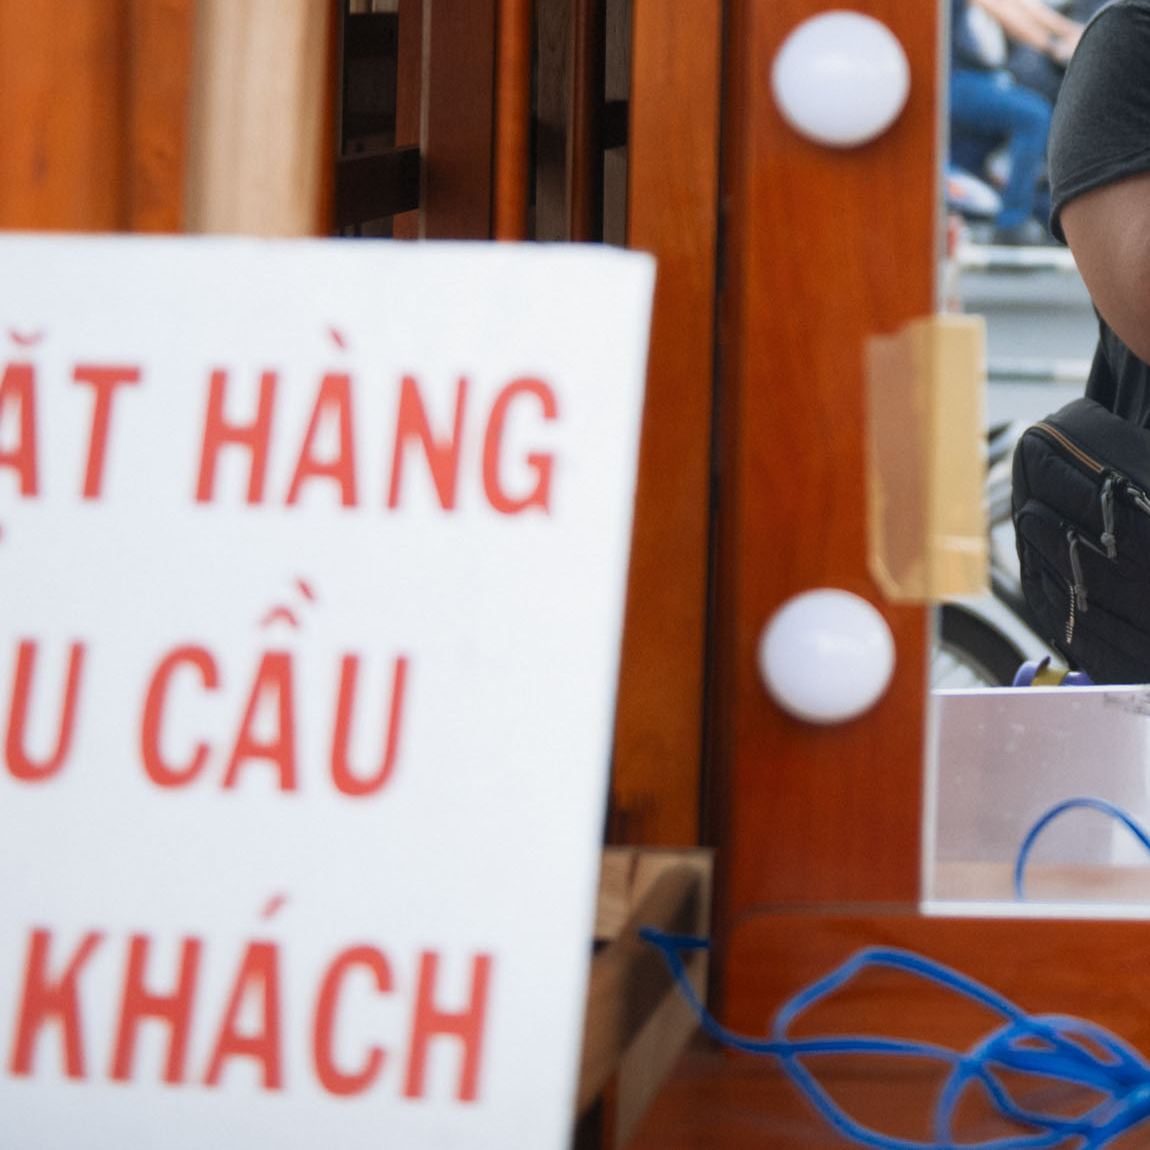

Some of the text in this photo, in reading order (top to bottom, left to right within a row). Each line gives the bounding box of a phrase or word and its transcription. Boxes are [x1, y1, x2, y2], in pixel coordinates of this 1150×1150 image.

[195, 327, 560, 515] HÀNG
[136, 579, 409, 798] CẦU
[8, 896, 493, 1104] KHÁCH
